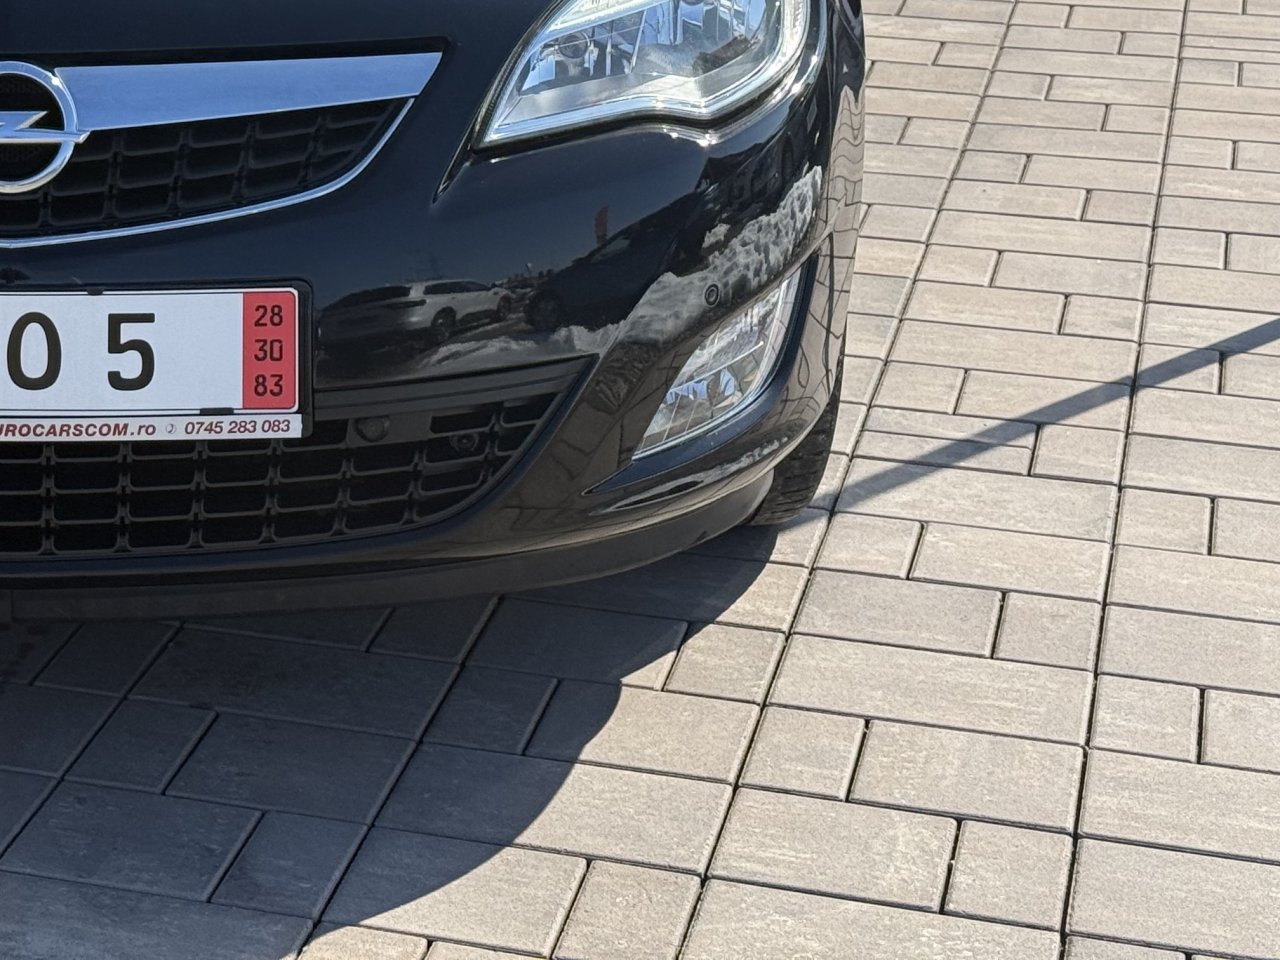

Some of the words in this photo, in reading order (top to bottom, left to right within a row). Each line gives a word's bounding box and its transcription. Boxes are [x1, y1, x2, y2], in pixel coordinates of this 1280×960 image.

[253, 304, 284, 327] 28
[107, 312, 156, 391] 5
[253, 338, 284, 362] 30
[253, 373, 284, 397] 83
[184, 421, 223, 435] 0745
[227, 420, 257, 434] 283
[261, 419, 291, 434] 083
